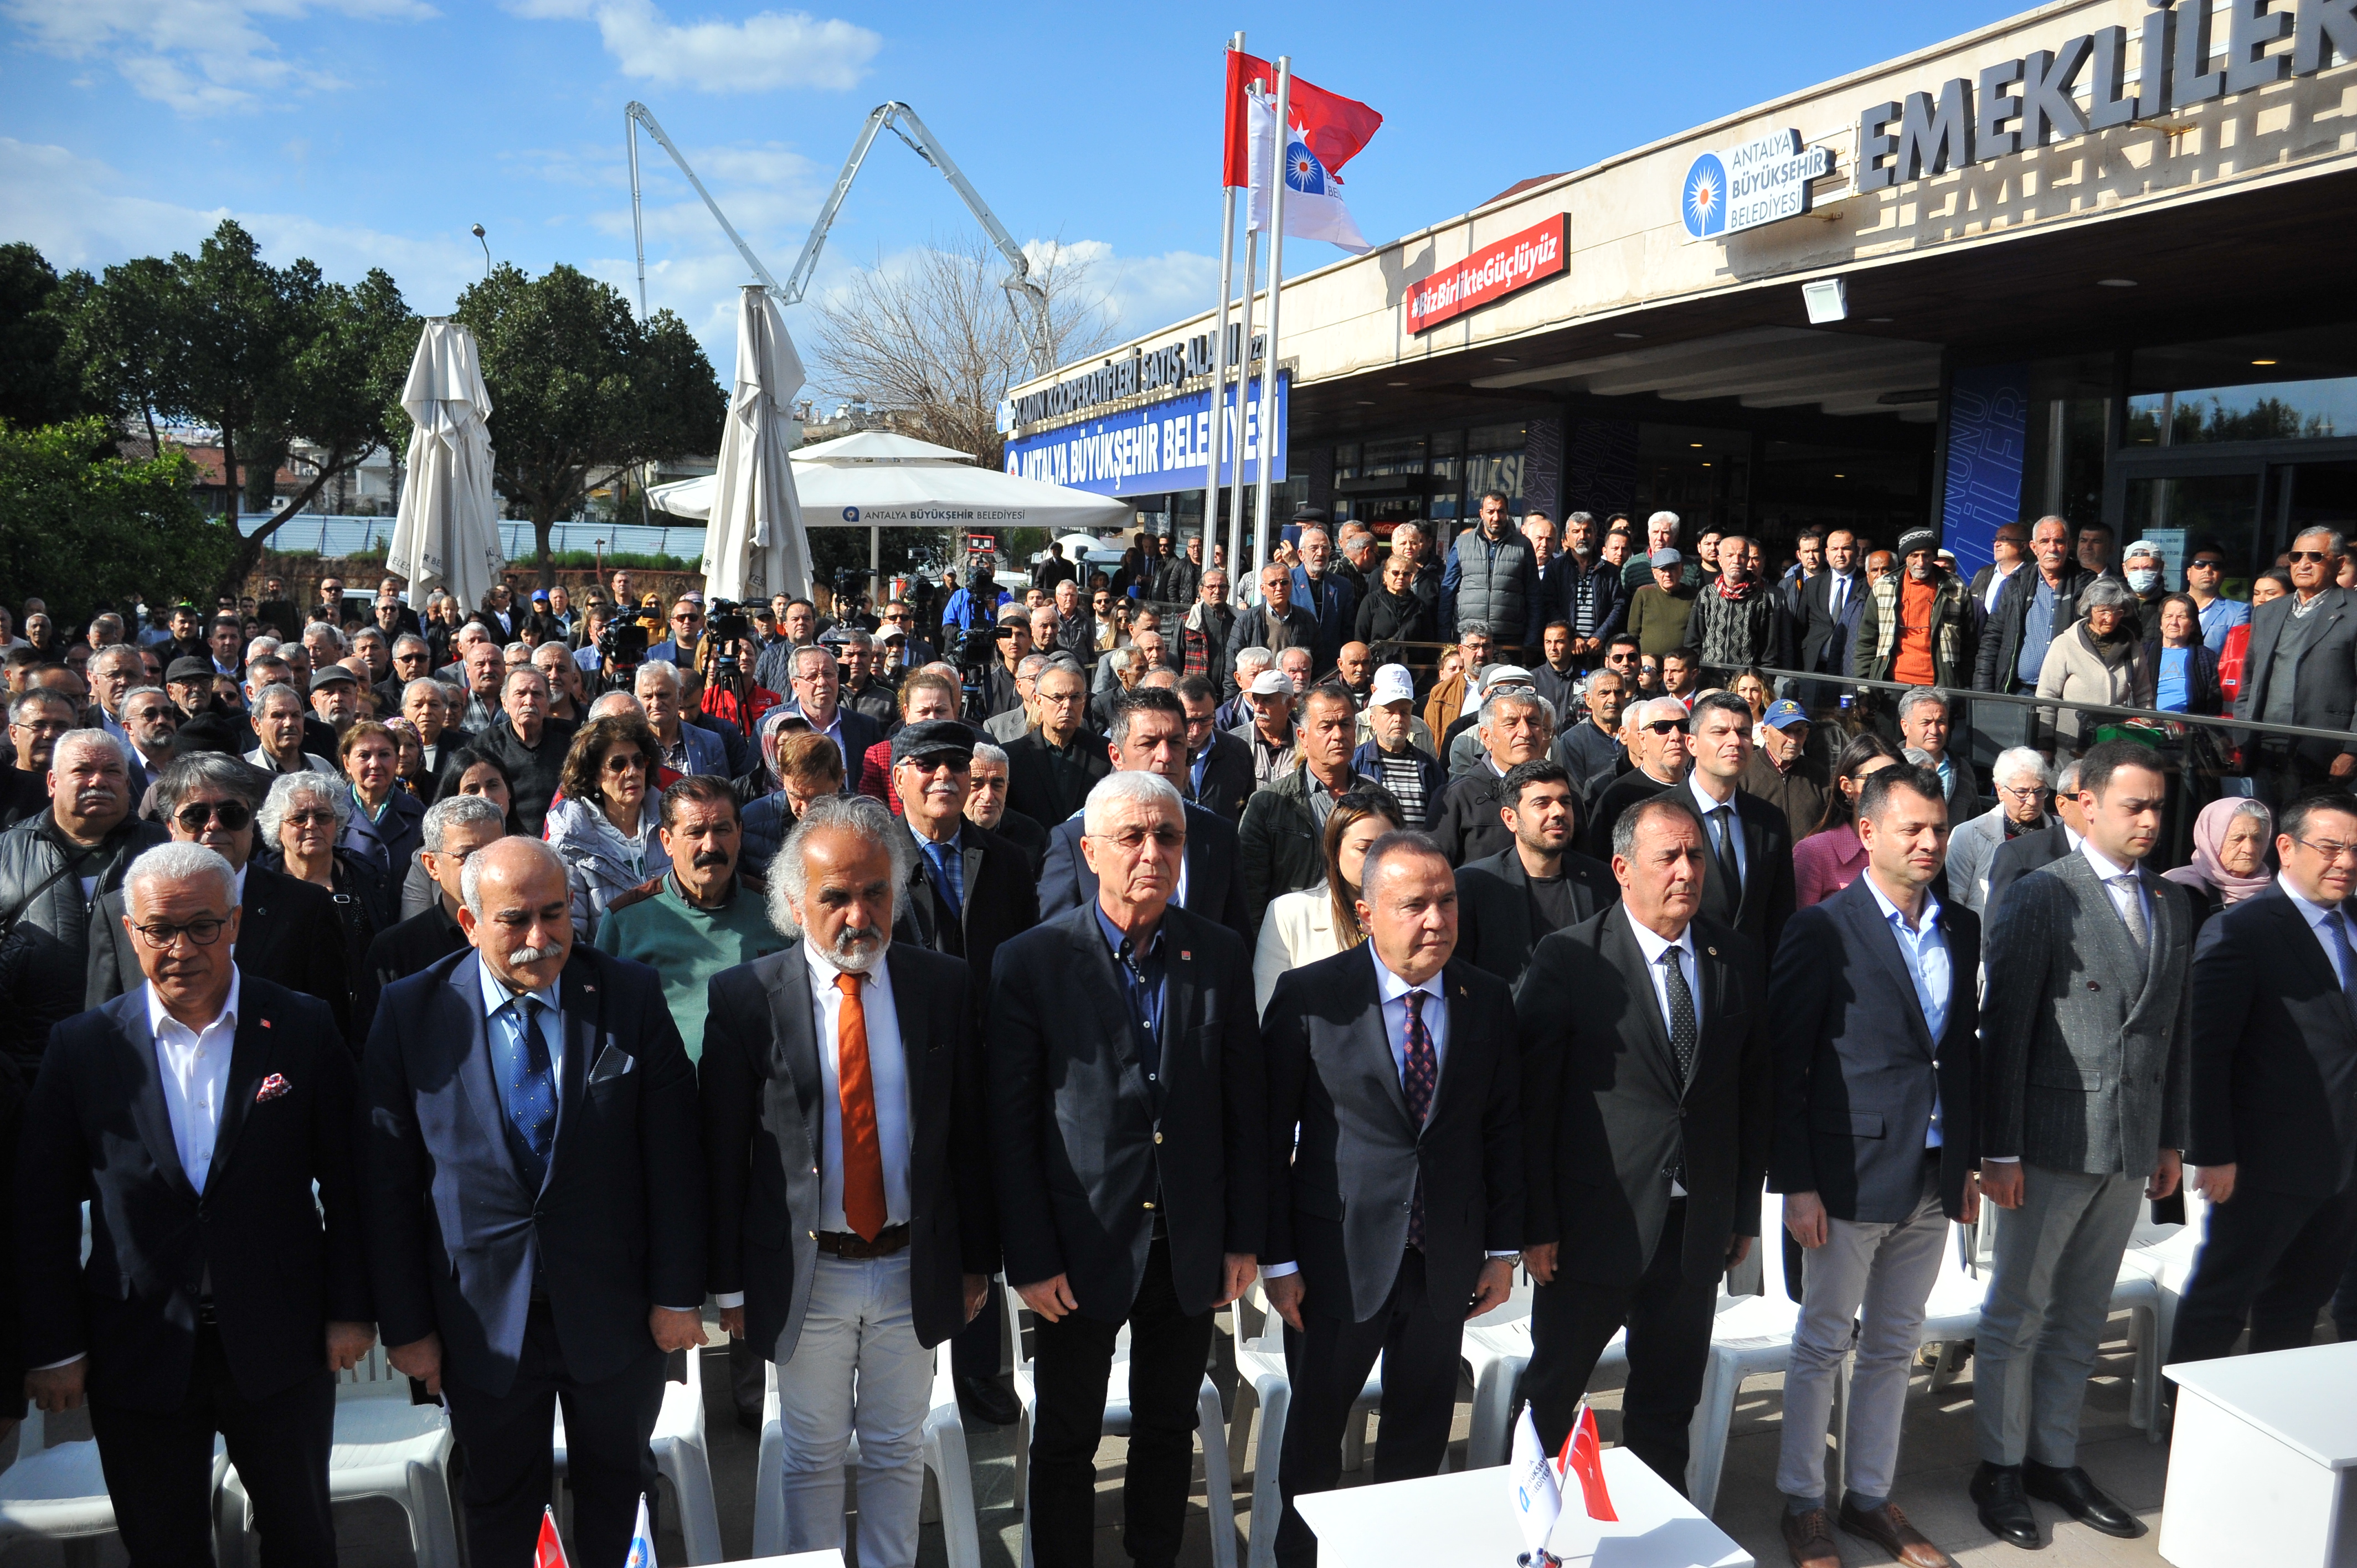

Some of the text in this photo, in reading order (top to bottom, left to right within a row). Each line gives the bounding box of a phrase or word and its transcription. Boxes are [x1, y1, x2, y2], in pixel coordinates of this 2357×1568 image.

[1732, 131, 1790, 169] ANTALYA
[1732, 147, 1824, 199] BÜYÜKŞEHİR
[1731, 185, 1801, 228] BELEDİYESİ
[1411, 232, 1557, 318] #BizBirlikteGüçlüyüz
[1017, 389, 1048, 425] KADIN
[1142, 342, 1185, 389] SATIŞ
[1022, 443, 1068, 486] ANTALYA
[1071, 412, 1159, 491] BÜYÜKŞEHİR
[864, 508, 1025, 521] ANTALYA BÜYÜKŞEHİR BELEDİYESİ
